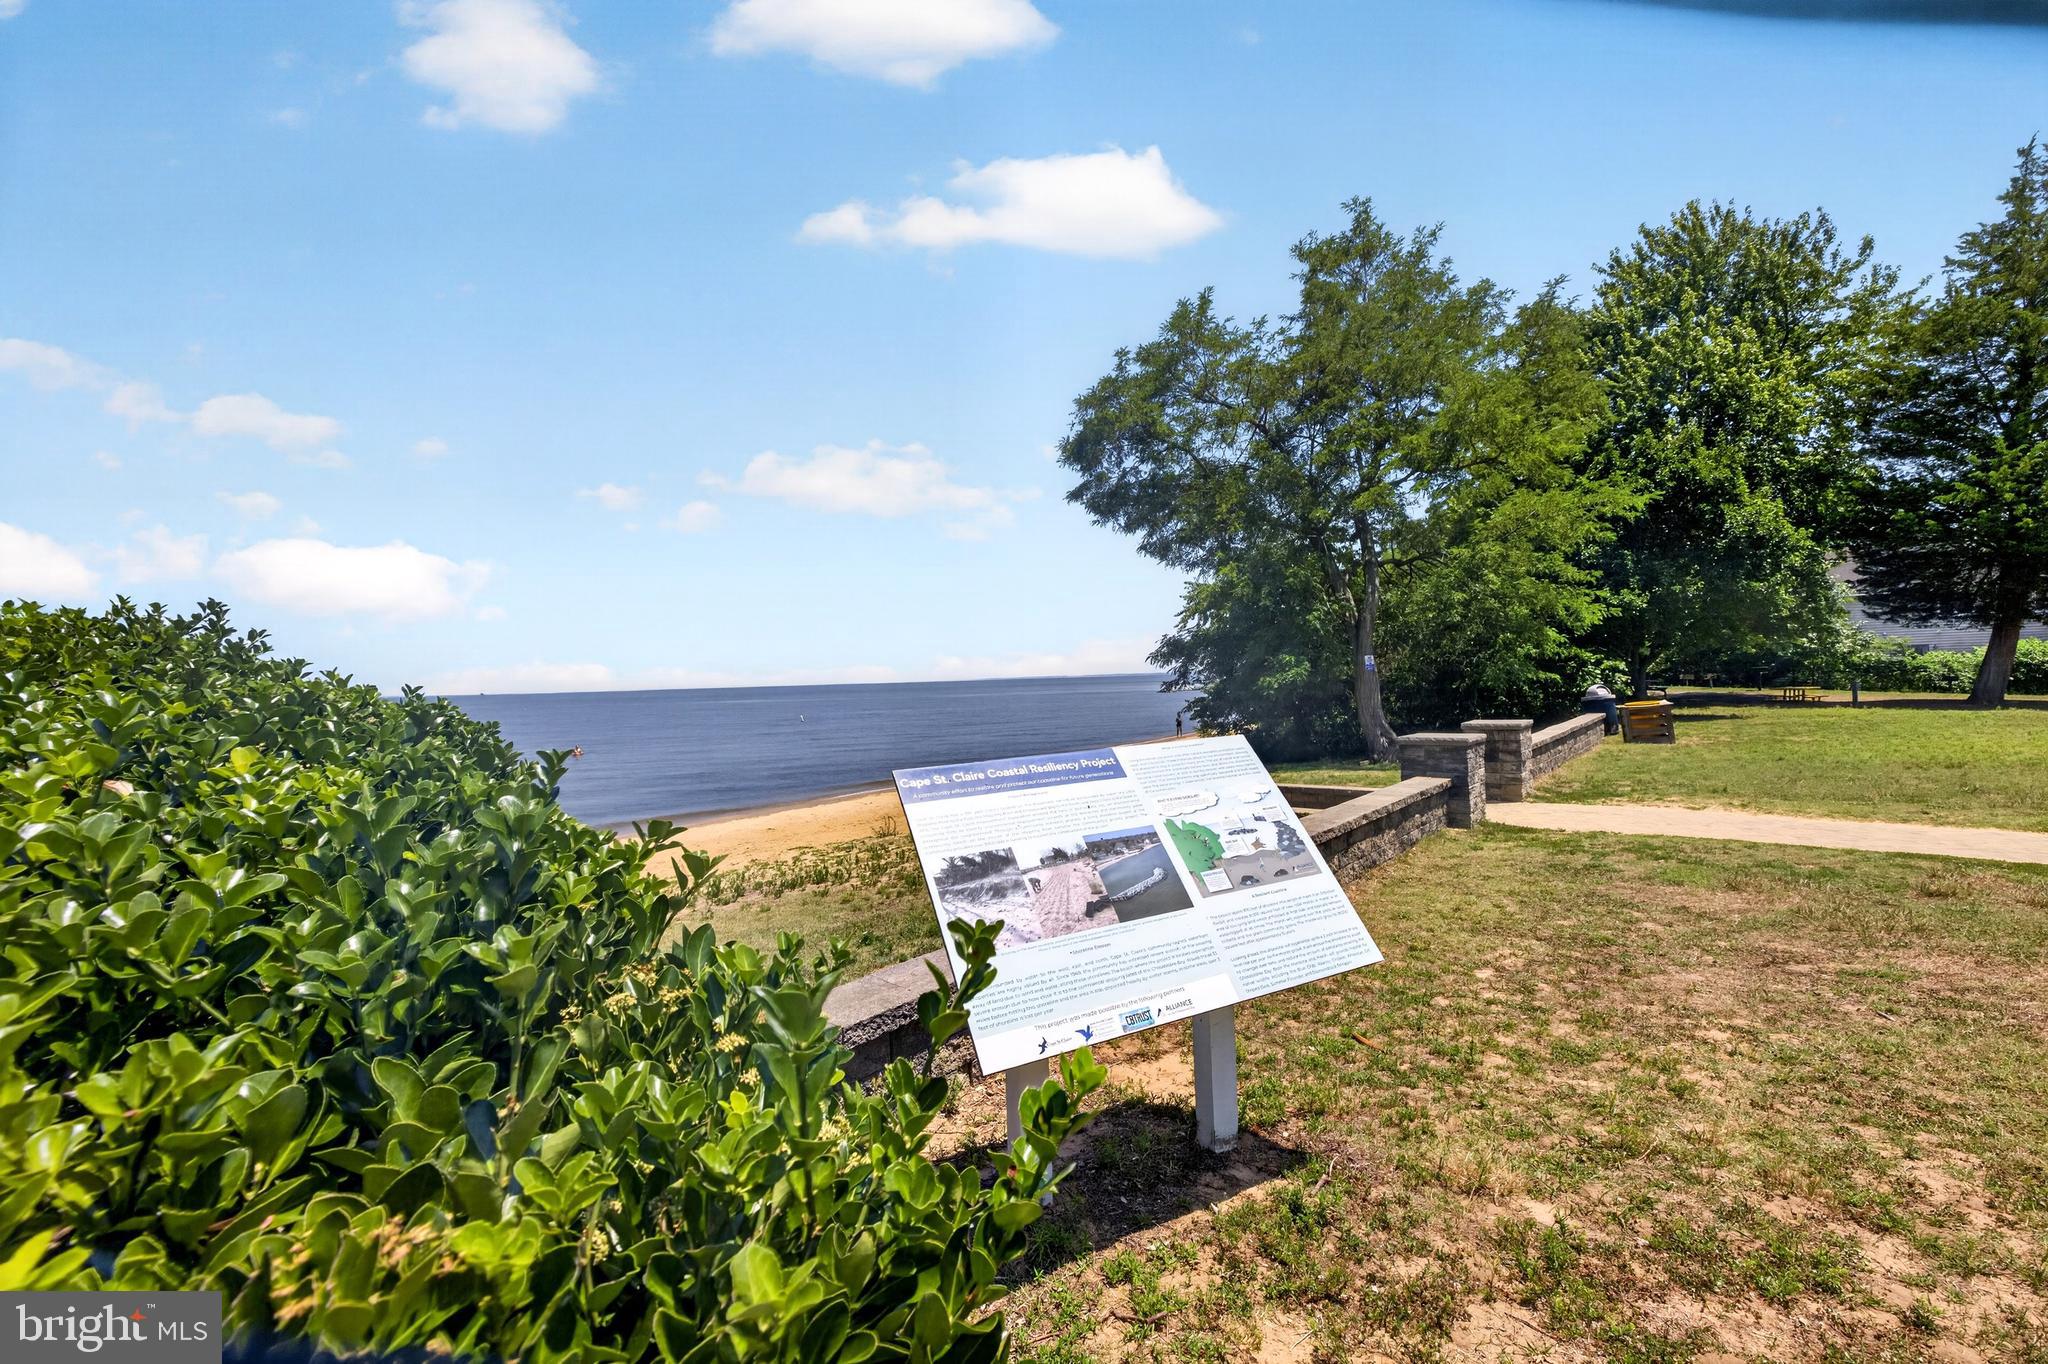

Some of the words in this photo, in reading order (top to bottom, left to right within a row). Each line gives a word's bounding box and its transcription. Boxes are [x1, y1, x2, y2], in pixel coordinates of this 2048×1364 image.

[899, 779, 931, 789] Cape
[932, 775, 951, 784] St.
[952, 772, 986, 782] Claire
[986, 766, 1030, 778] Coastal
[1029, 763, 1081, 773] Resiliency
[1080, 756, 1117, 768] Project
[918, 790, 951, 798] community
[1007, 780, 1028, 788] protect
[1164, 998, 1194, 1012] ALLIANCE
[1034, 1023, 1047, 1031] This
[1047, 1017, 1069, 1029] project
[1081, 1010, 1098, 1019] made
[1124, 1009, 1154, 1027] CBTRUST
